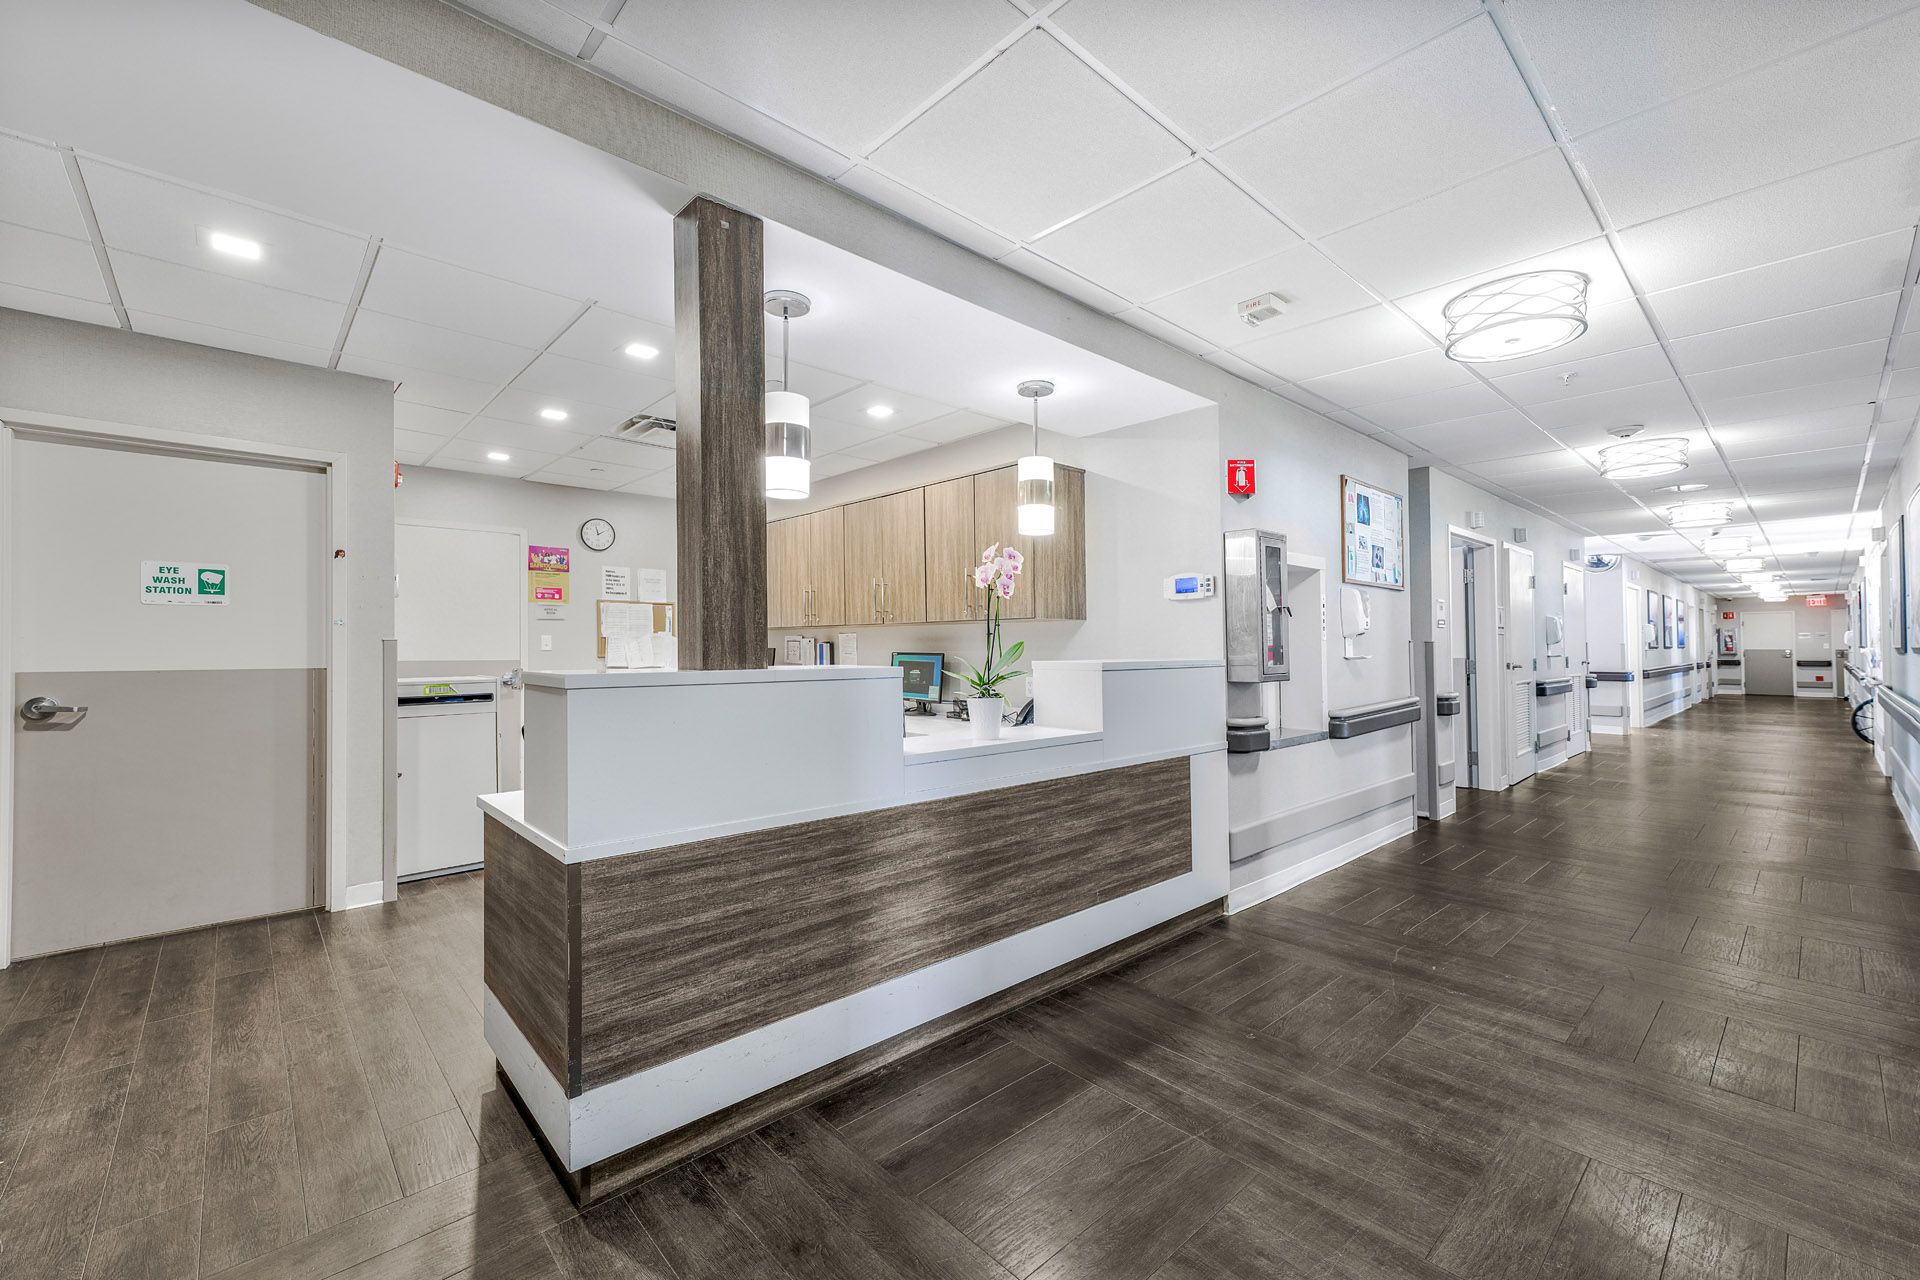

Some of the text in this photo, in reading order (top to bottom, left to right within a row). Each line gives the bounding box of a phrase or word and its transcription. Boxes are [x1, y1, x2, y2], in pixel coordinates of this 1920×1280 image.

[159, 566, 180, 574] EYE
[152, 576, 185, 585] WASH
[145, 586, 192, 595] STATION
